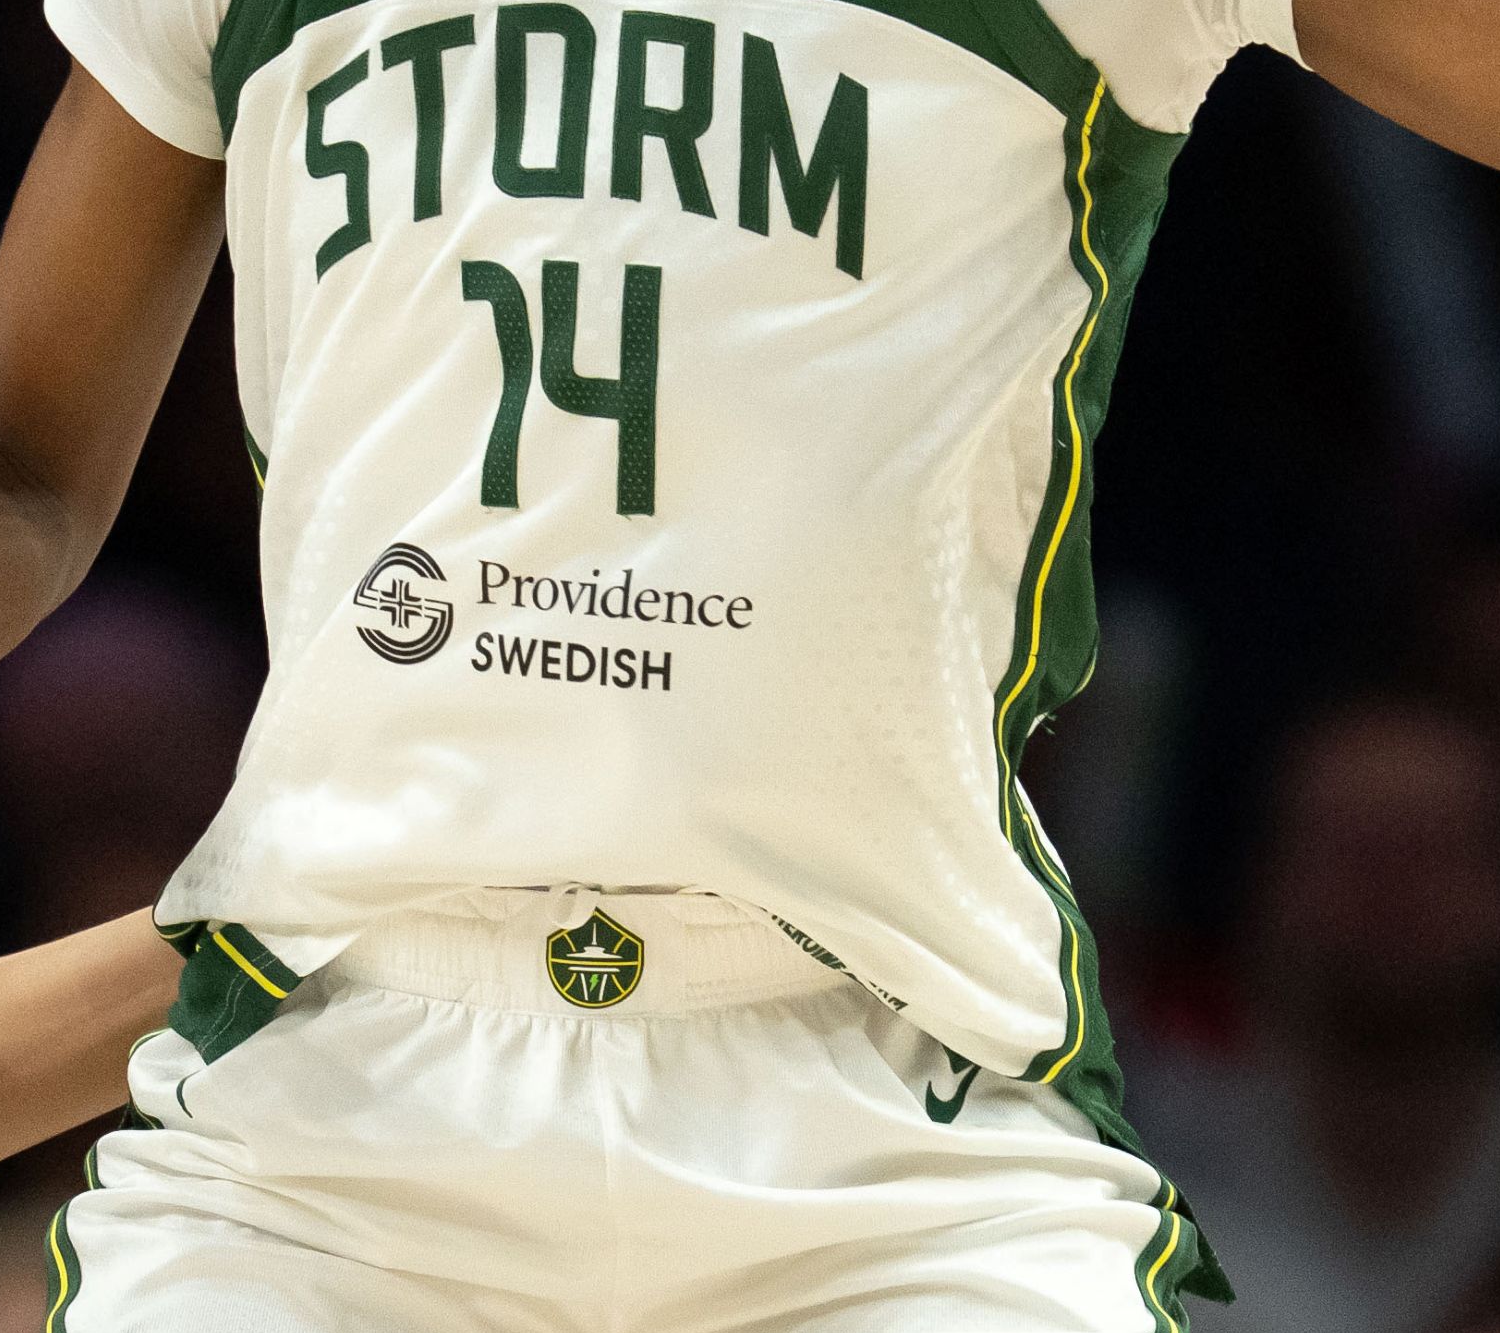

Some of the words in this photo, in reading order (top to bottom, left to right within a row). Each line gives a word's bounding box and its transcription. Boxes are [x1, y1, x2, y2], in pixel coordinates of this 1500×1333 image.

[305, 1, 869, 284] STORM
[460, 258, 663, 517] 14
[470, 631, 672, 691] SWEDISH
[476, 559, 753, 629] Providence
